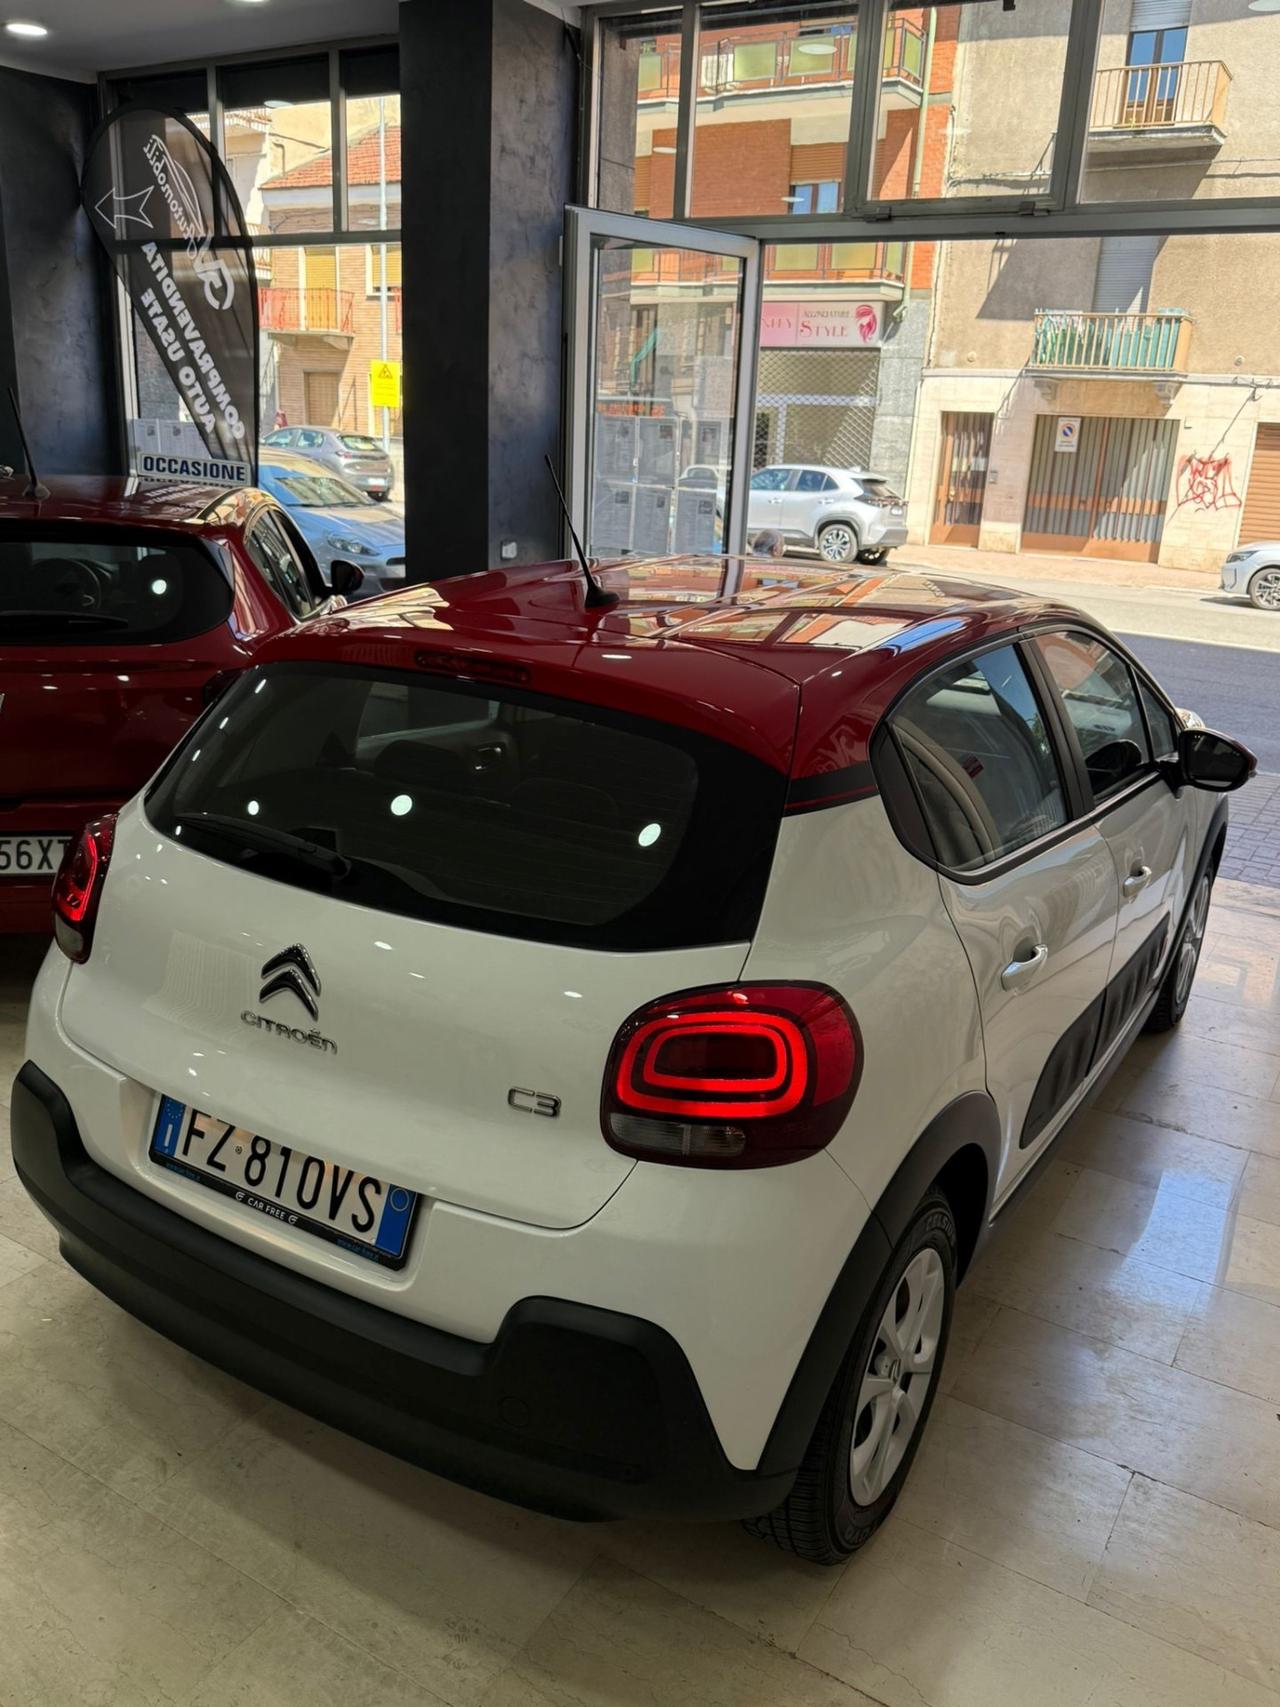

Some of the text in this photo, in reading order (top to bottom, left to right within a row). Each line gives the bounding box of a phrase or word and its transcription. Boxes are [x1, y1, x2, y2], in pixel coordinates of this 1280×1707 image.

[143, 456, 246, 481] OCCASIONE
[508, 1086, 562, 1118] C3
[248, 1197, 286, 1221] CAR FREE
